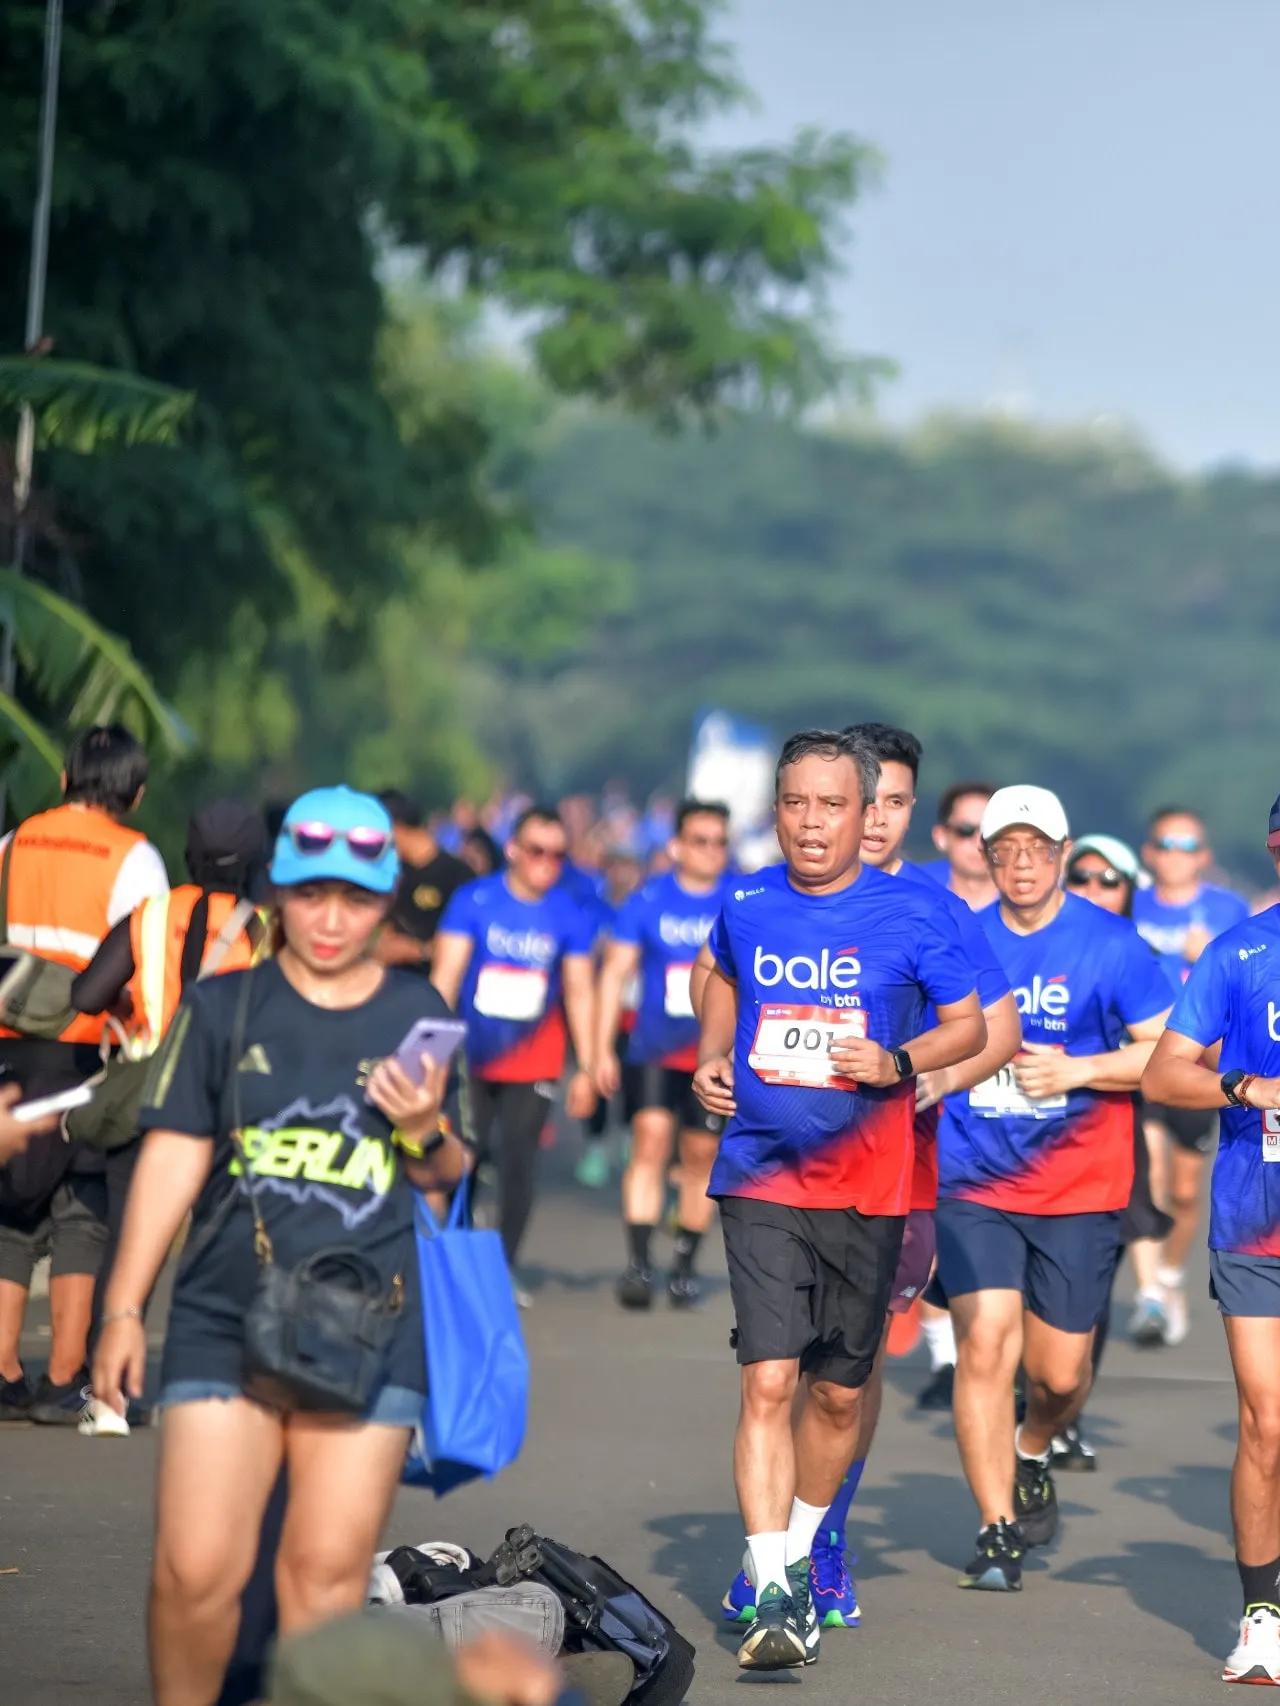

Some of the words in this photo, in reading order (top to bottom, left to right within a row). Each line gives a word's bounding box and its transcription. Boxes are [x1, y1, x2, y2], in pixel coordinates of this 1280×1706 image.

[753, 945, 861, 990] balé
[1013, 974, 1070, 1016] alé
[228, 1126, 396, 1196] BERLIN
